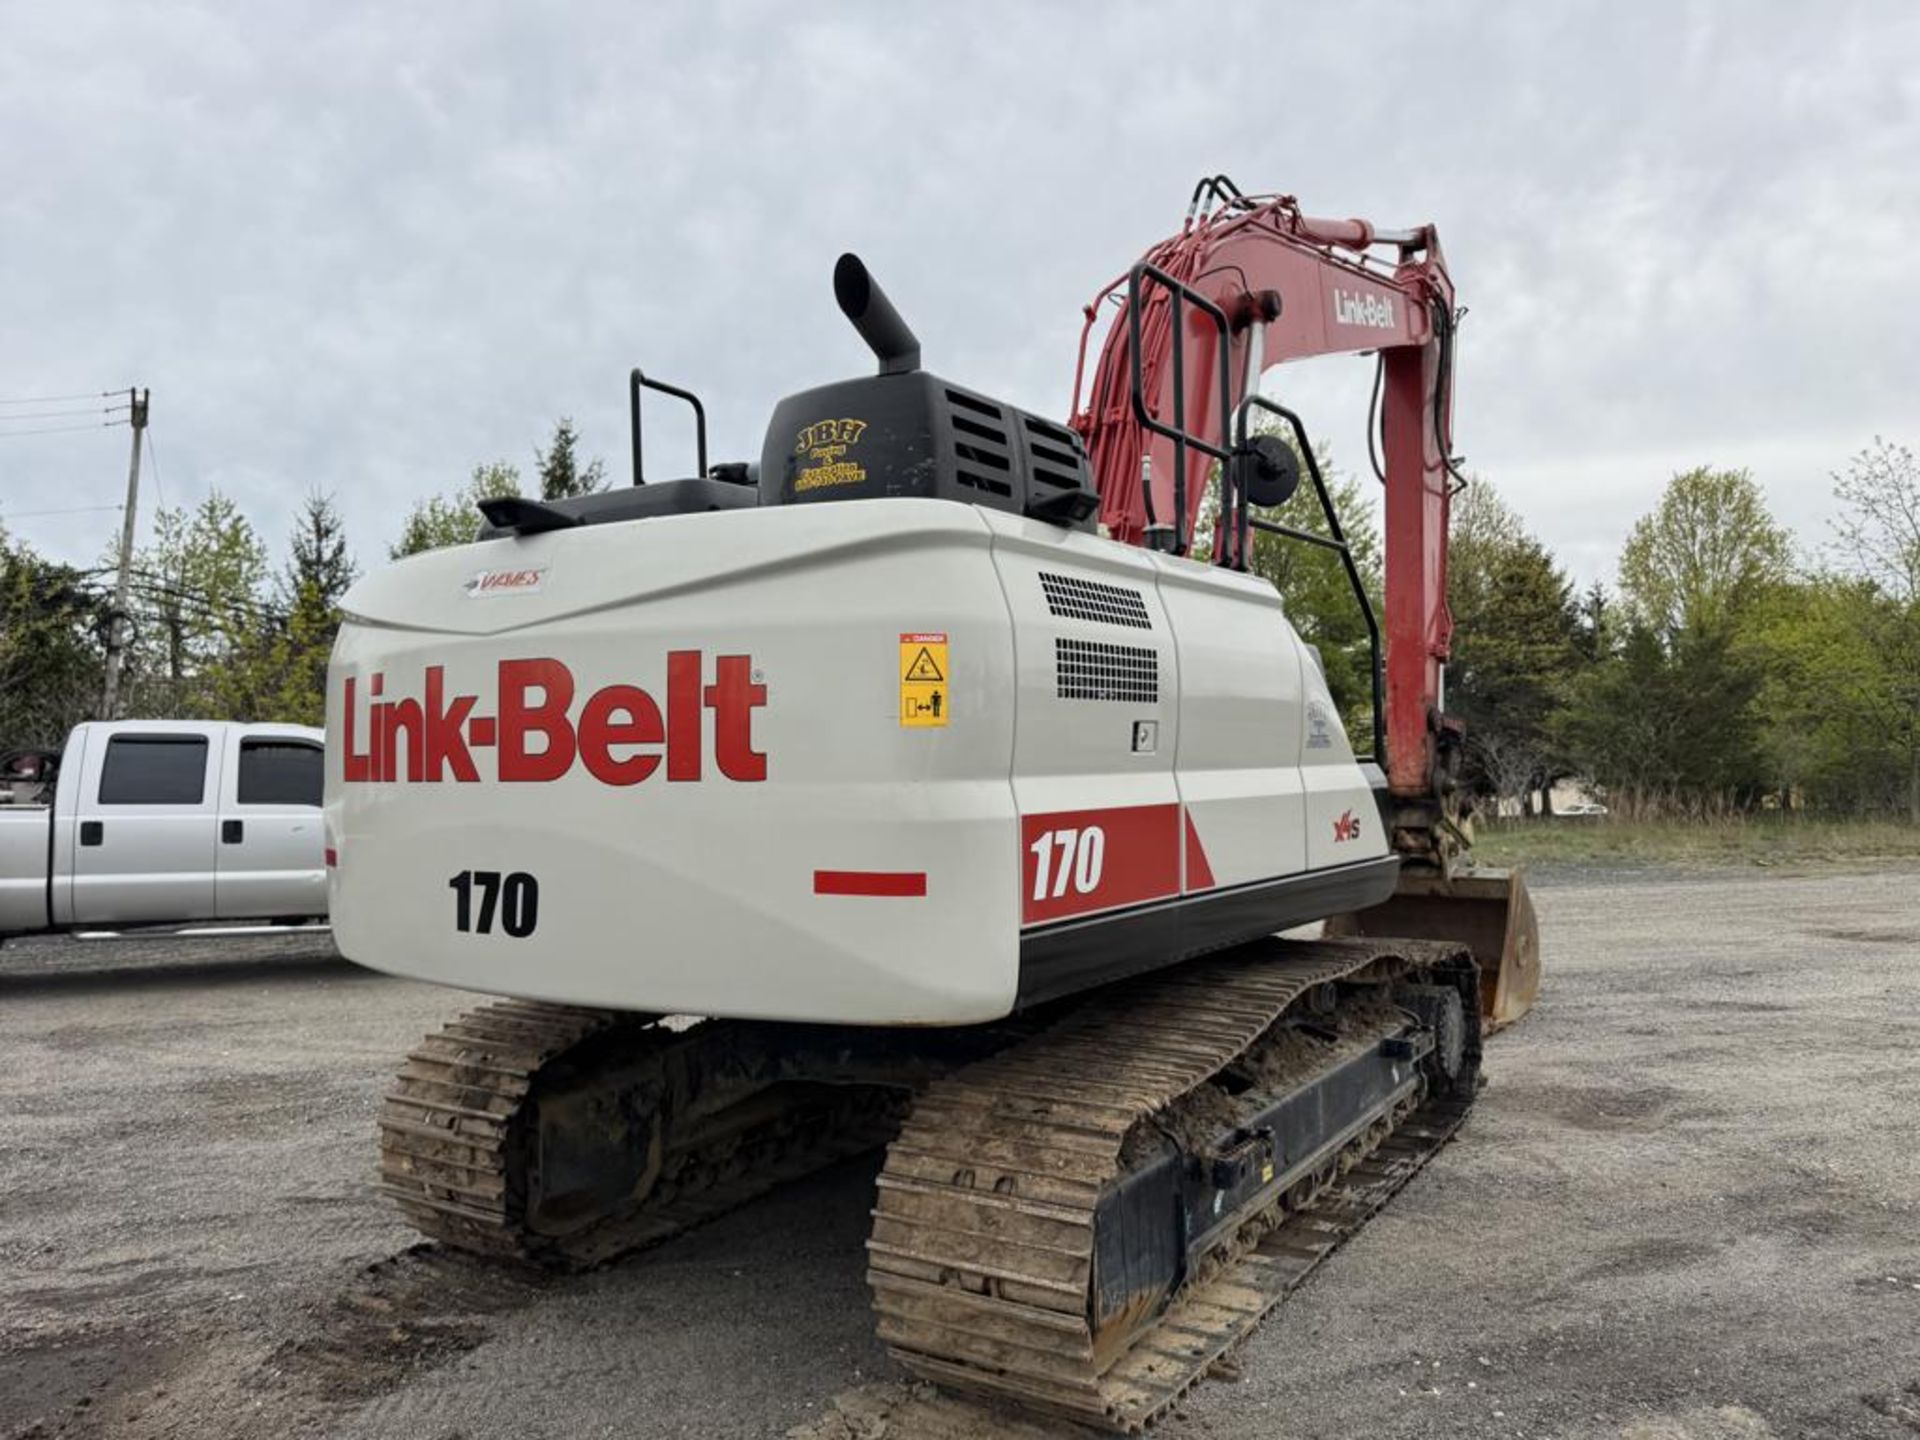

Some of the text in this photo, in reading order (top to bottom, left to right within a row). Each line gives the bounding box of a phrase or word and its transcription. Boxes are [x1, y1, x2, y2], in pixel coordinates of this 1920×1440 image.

[1334, 288, 1395, 328] Link-Belt
[343, 650, 767, 786] Link-Belt
[1031, 826, 1105, 901] 170
[449, 870, 539, 938] 170
